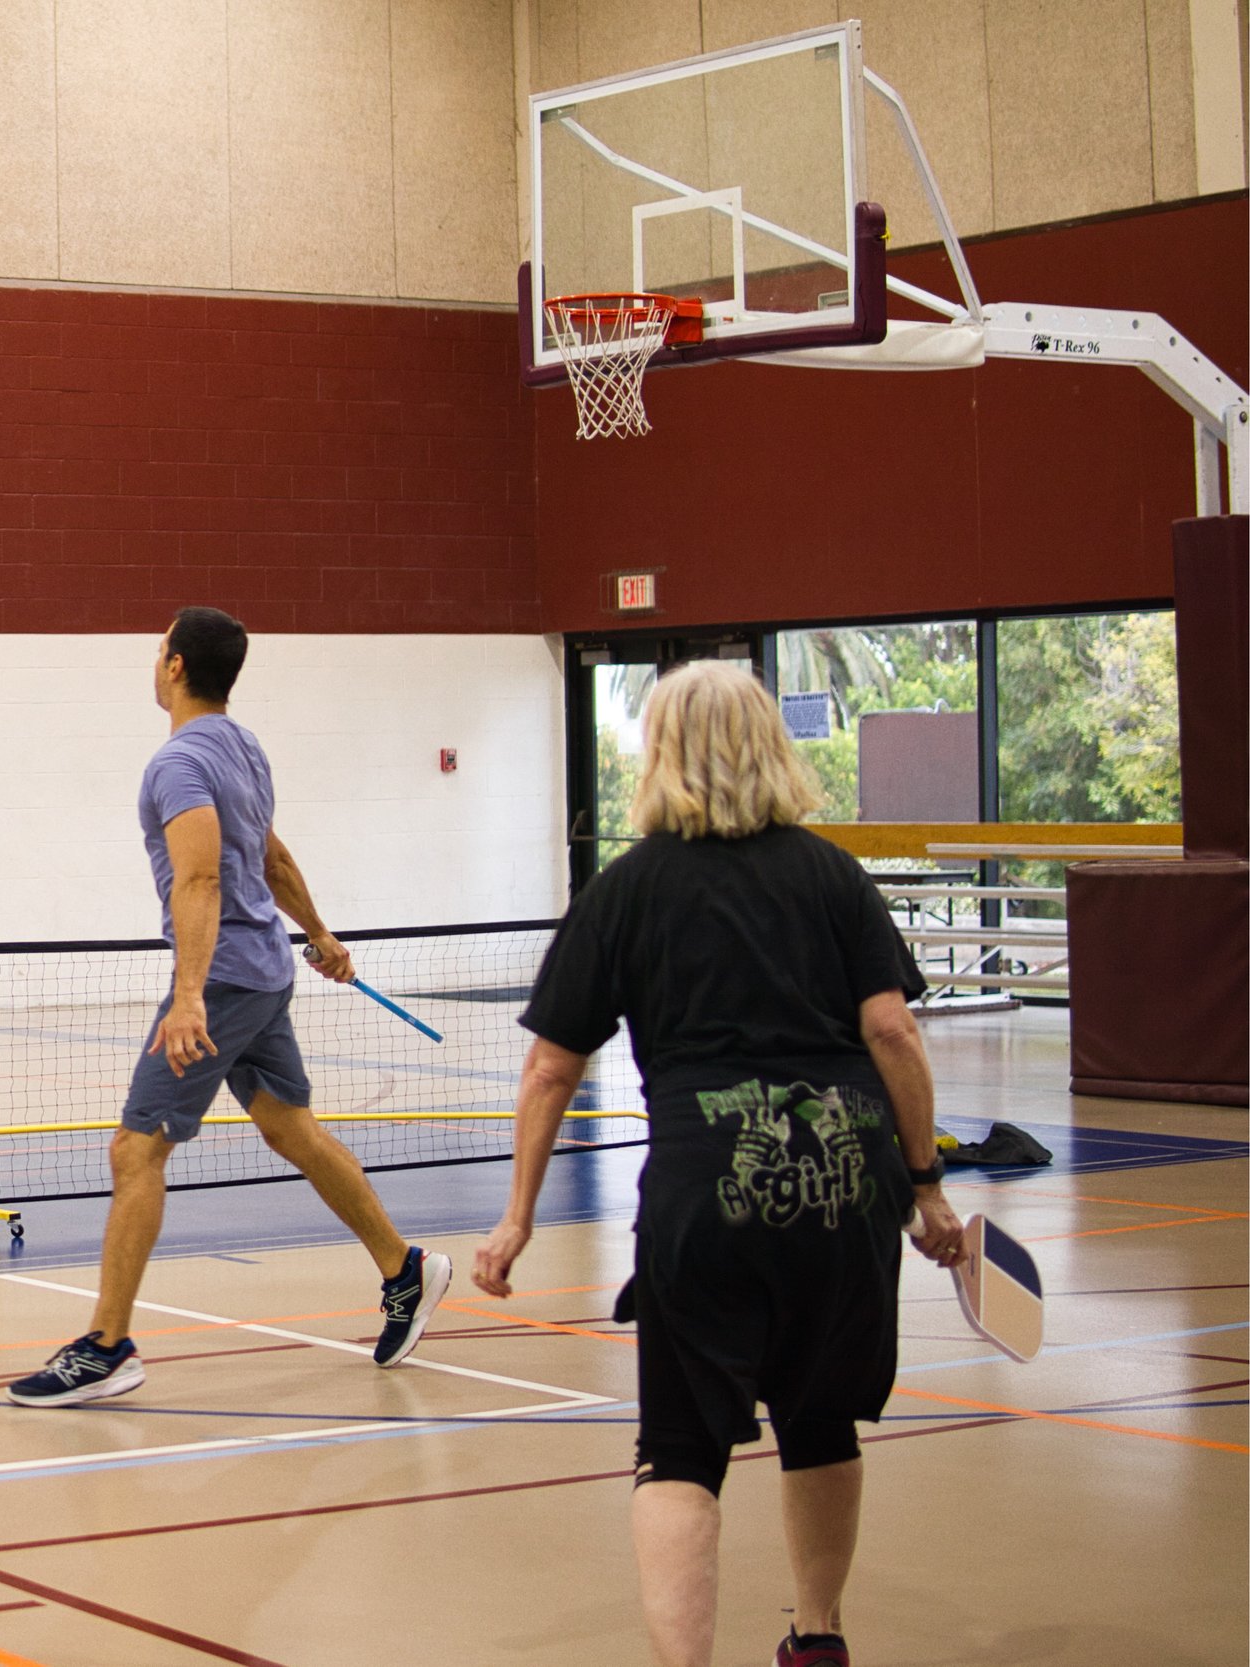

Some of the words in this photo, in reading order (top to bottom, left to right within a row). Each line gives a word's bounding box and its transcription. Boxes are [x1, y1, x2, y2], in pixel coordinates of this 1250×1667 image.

[1054, 338, 1085, 354] T-Rex
[1087, 340, 1099, 354] 96
[623, 578, 646, 606] EXIT
[719, 1177, 749, 1218] A
